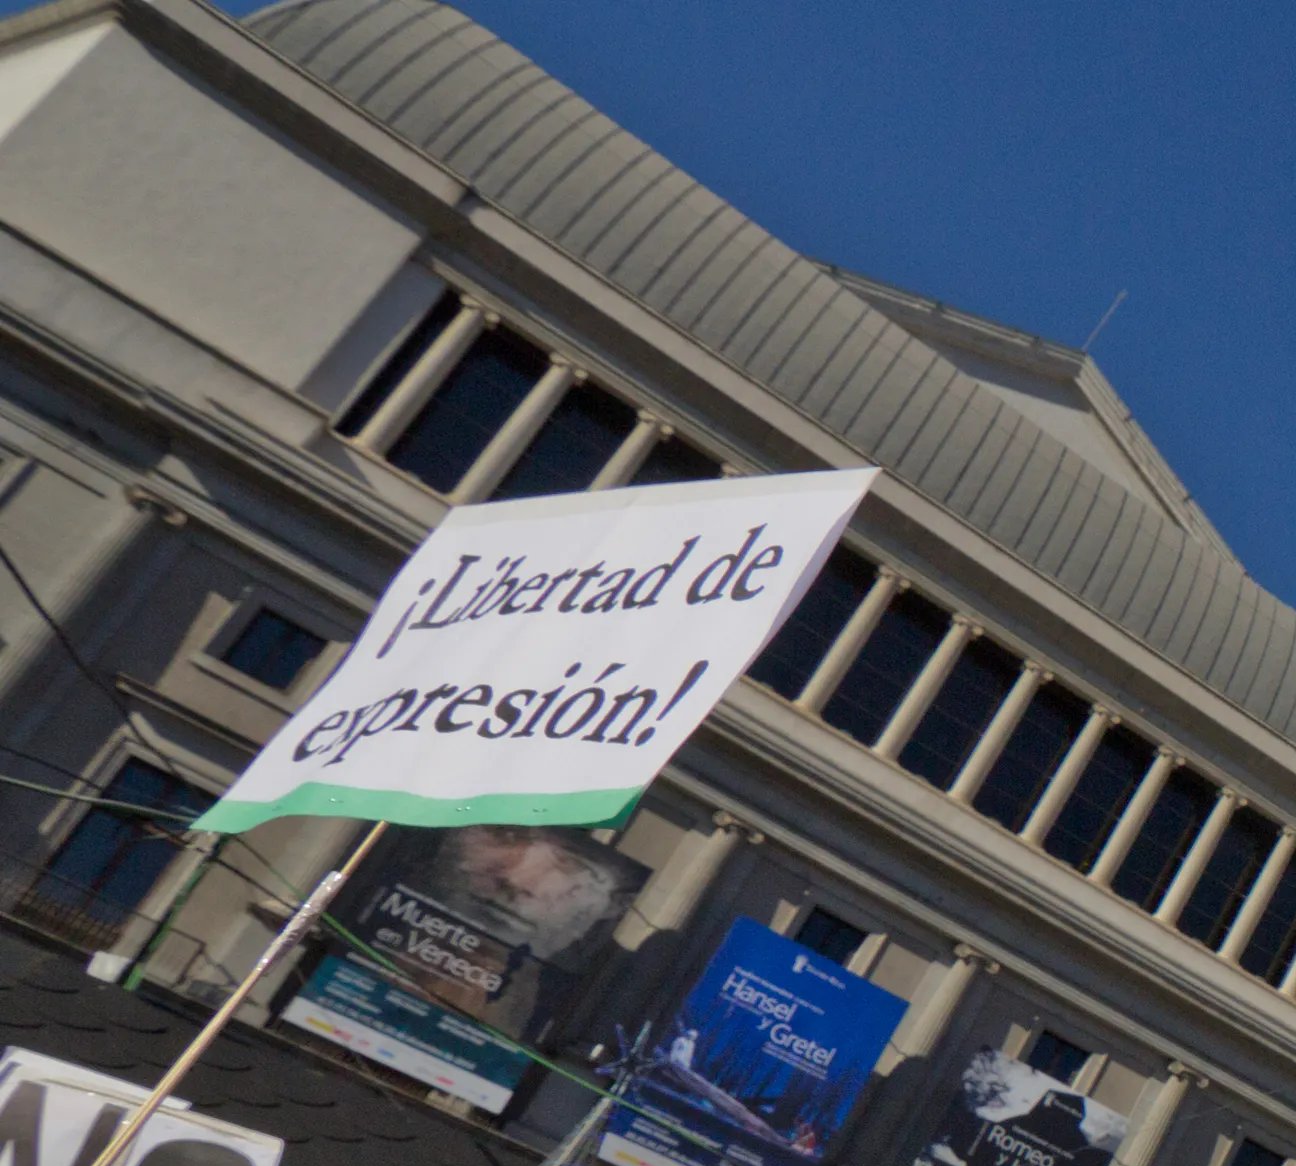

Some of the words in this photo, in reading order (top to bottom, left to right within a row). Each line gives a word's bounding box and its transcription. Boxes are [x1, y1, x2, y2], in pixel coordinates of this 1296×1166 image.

[375, 535, 702, 660] ¡Libertad
[686, 523, 785, 606] de
[292, 659, 710, 768] expresión!
[380, 891, 481, 953] Muerte
[722, 972, 798, 1022] Hansel
[756, 1016, 774, 1031] y
[769, 1022, 838, 1067] Gretel
